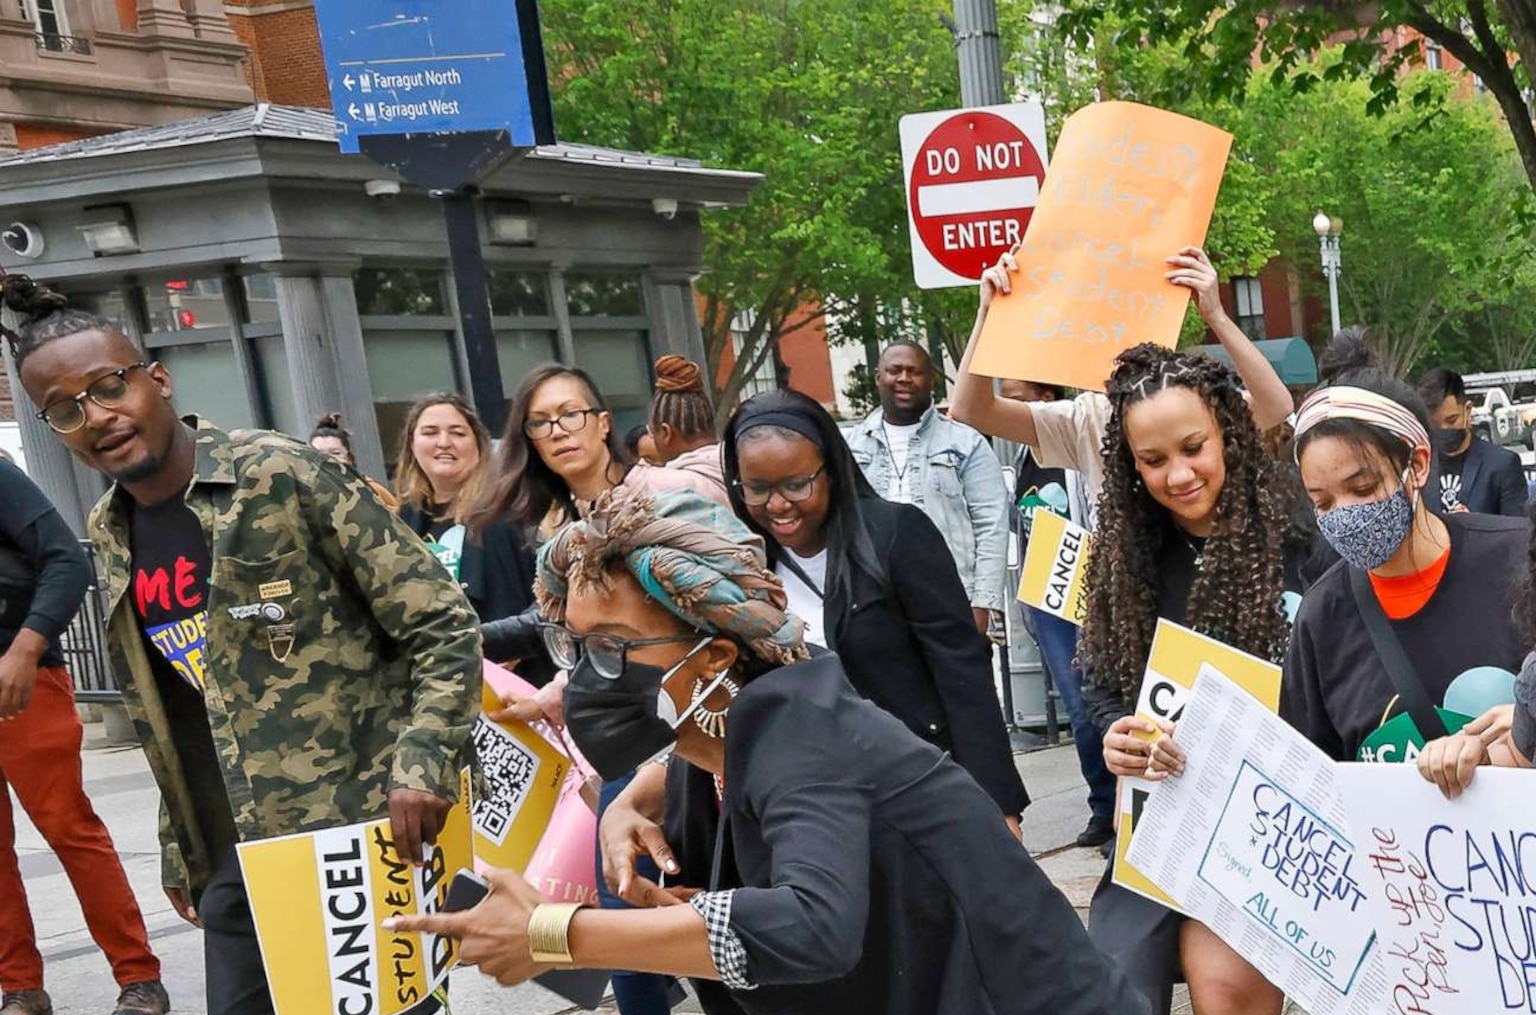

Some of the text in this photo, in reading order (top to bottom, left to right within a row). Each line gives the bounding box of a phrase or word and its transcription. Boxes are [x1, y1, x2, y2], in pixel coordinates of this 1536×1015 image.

[373, 71, 424, 92] Farragut
[425, 67, 461, 87] North
[379, 102, 429, 120] Farragut
[430, 99, 460, 115] West
[926, 141, 1022, 176] DO NOT
[942, 218, 1021, 250] ENTER
[1045, 531, 1082, 610] CANCEL
[1250, 811, 1367, 912] STUDENT
[1253, 783, 1358, 887] CANCEL
[1369, 826, 1405, 880] the
[1262, 843, 1331, 911] DEBT
[1385, 883, 1412, 926] up
[1407, 851, 1445, 923] Joe
[1246, 891, 1336, 967] ALL OF US
